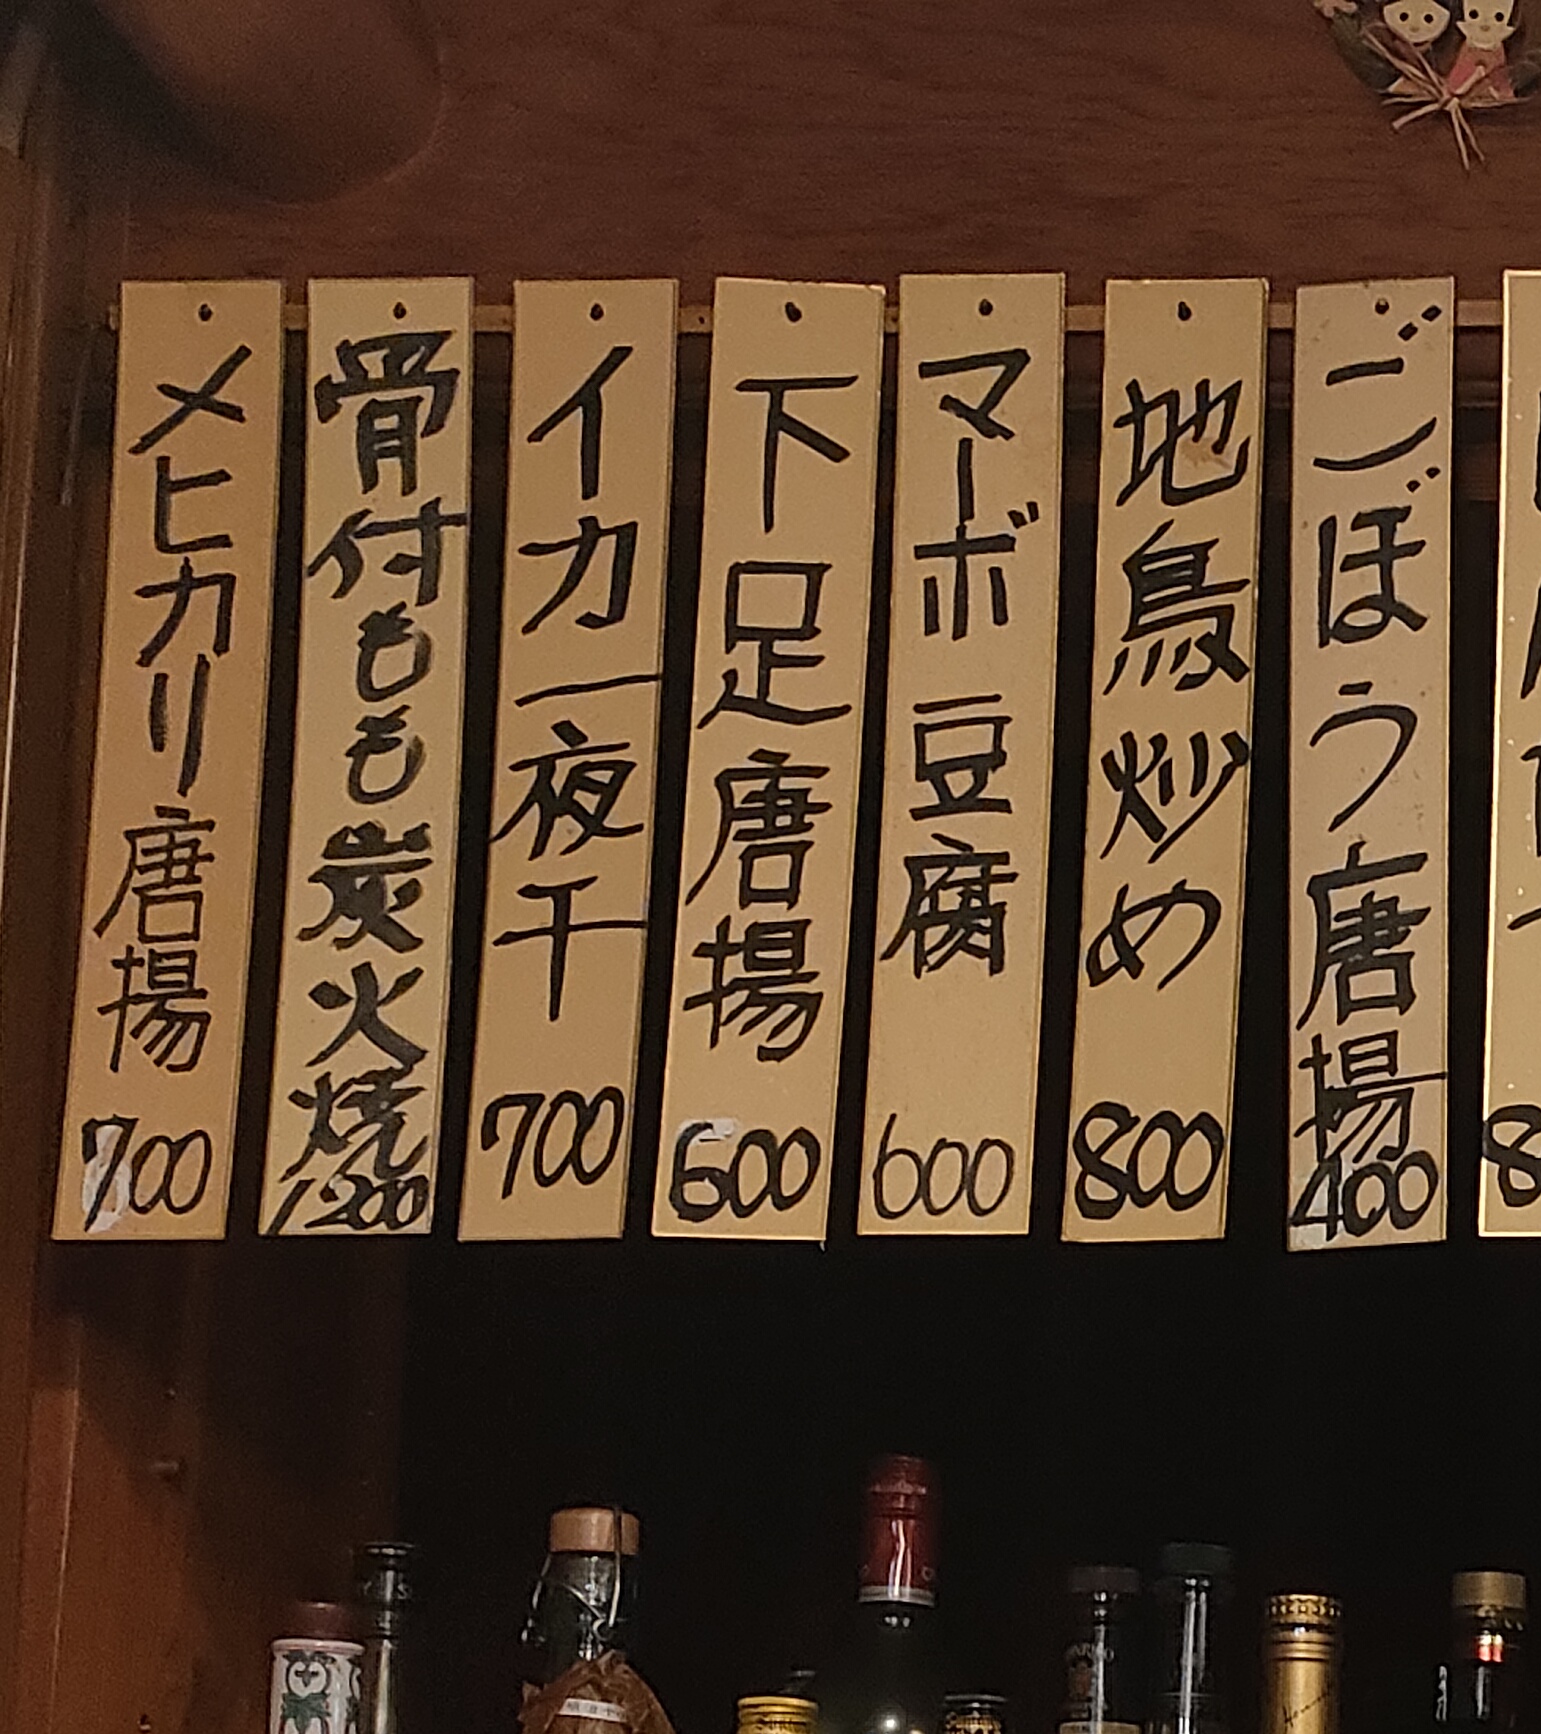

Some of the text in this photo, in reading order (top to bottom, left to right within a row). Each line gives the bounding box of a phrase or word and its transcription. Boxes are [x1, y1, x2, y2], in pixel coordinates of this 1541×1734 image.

[93, 344, 252, 1073] メヒカリ唐揚
[281, 330, 469, 1182] 骨付もも炭火焼
[489, 345, 663, 1021] イカ一夜干
[683, 375, 859, 1062] 下足唐揚
[880, 348, 1040, 978] マーボ豆腐
[1085, 378, 1253, 992] 地鳥炒め
[1295, 306, 1448, 1163] ごぼう唐揚
[80, 1115, 212, 1231] 700
[482, 1087, 621, 1198] 700
[669, 1118, 820, 1222] 600
[872, 1114, 1015, 1220] 600
[1072, 1101, 1224, 1220] 800
[1290, 1151, 1438, 1241] 400
